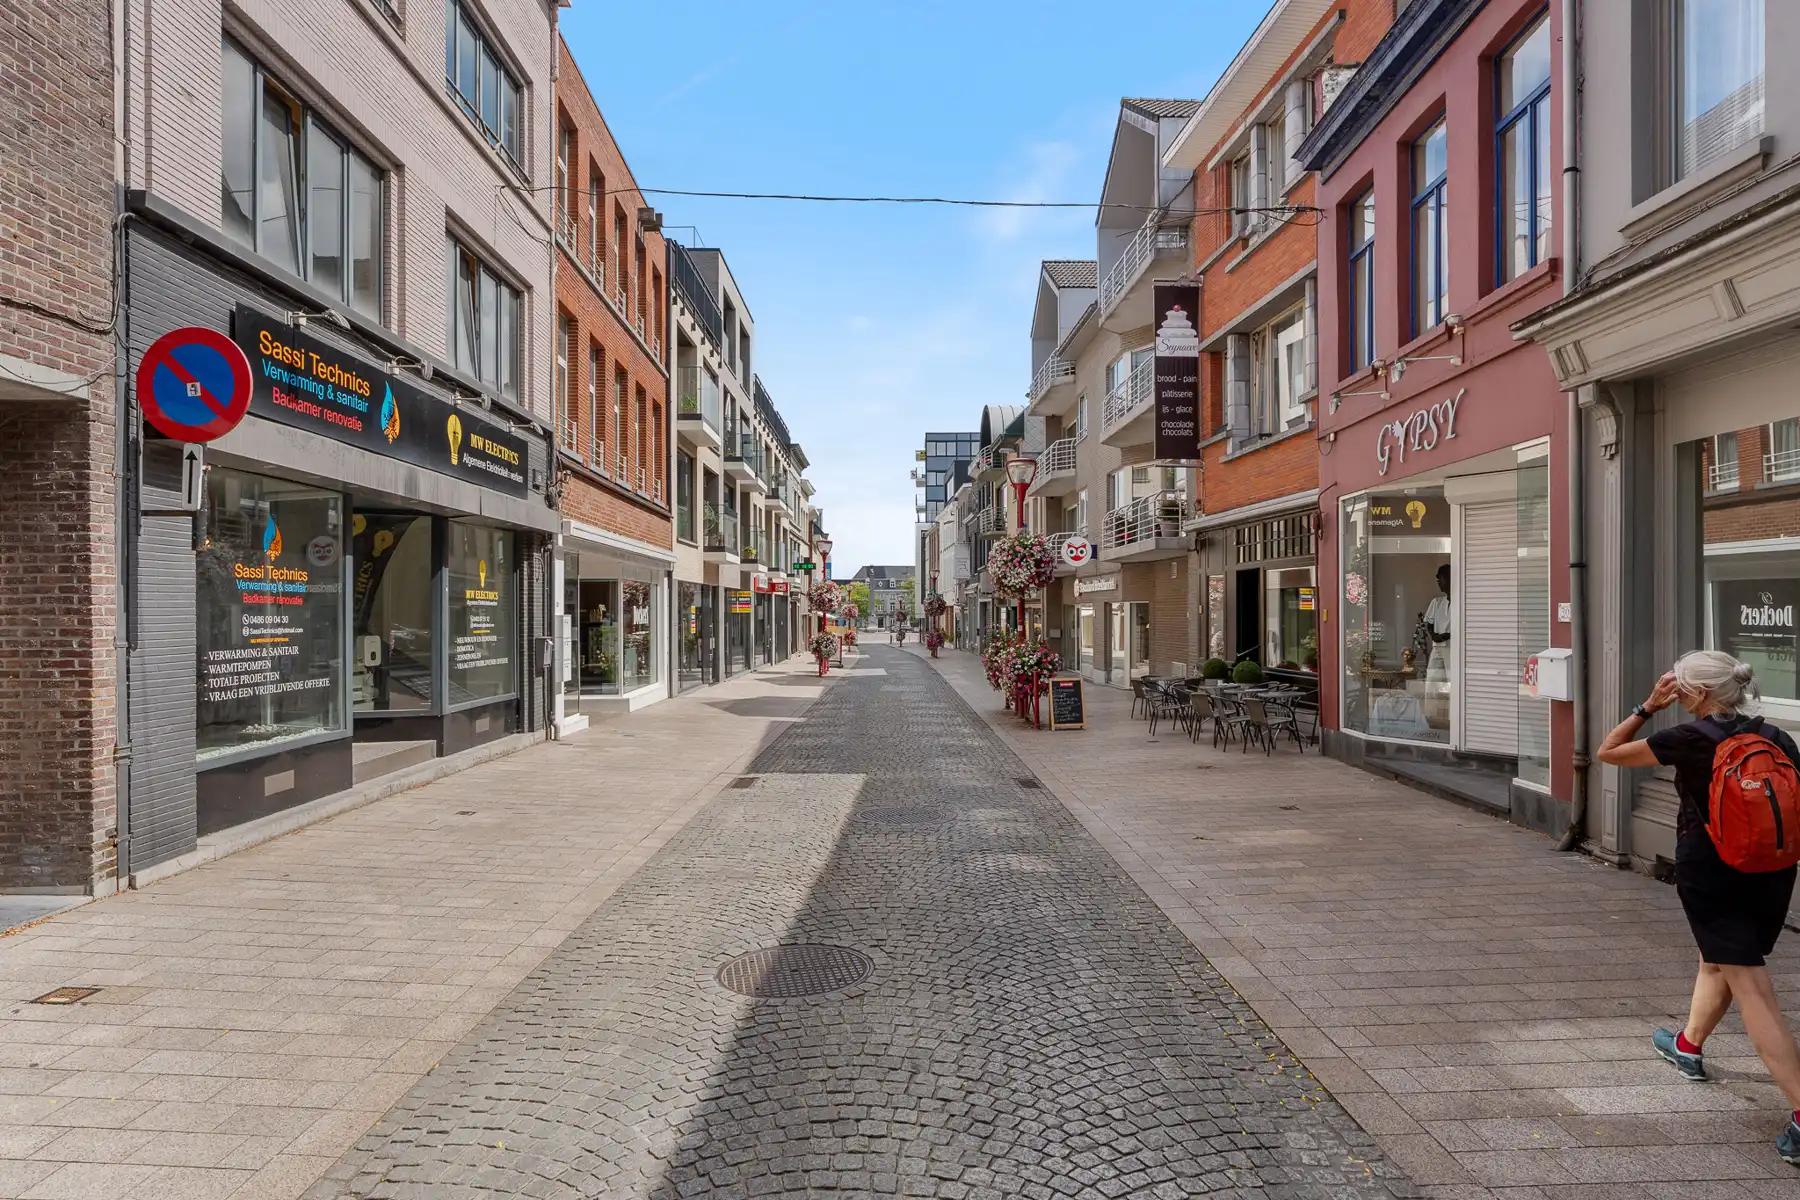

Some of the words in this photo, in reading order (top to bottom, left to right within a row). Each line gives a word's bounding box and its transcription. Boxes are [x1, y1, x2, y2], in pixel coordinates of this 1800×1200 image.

[260, 330, 305, 370] Sassi
[309, 351, 371, 397] Technics
[262, 358, 325, 400] Verwarming
[326, 384, 334, 401] &
[336, 391, 369, 413] sanitair
[1157, 375, 1177, 383] brood
[1183, 375, 1198, 383] pain
[1162, 389, 1193, 398] pâtisserie
[272, 386, 322, 418] Badkamer
[323, 408, 363, 432] renovatie
[1175, 405, 1193, 414] glace
[1161, 420, 1194, 428] chocolade
[1162, 428, 1193, 436] chocolats
[1377, 387, 1465, 477] GYPSY
[470, 433, 484, 451] MW
[234, 563, 264, 579] Sassi
[266, 565, 308, 581] Technics
[236, 579, 277, 593] Verwarming
[208, 648, 261, 661] VERWARMING
[268, 646, 300, 657] SANITAIR
[208, 660, 272, 675] WARMTEPOMPEN
[208, 675, 239, 688] TOTALE
[240, 672, 280, 685] PROJECTEN
[209, 688, 238, 702] VRAAG
[239, 687, 254, 698] EEN
[304, 678, 330, 689] OFFERTE
